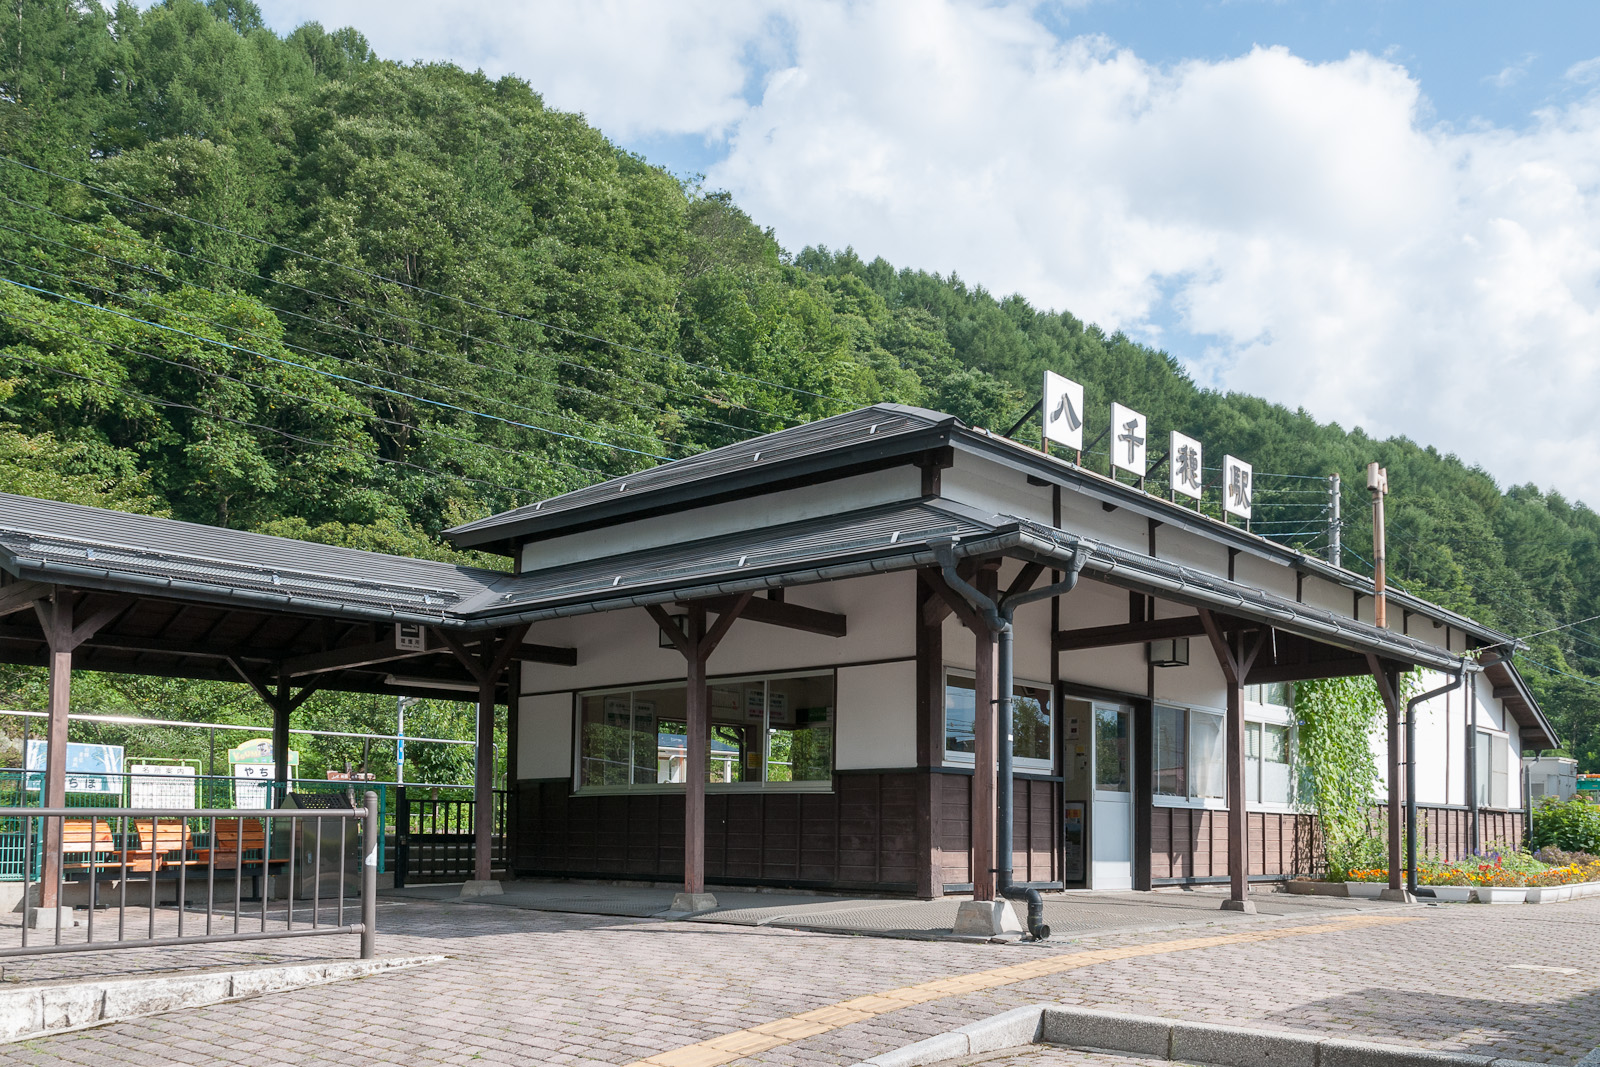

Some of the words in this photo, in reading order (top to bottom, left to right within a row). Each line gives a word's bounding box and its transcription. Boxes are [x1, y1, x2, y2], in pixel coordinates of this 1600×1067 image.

[1050, 392, 1251, 510] 八千穂駅
[142, 766, 185, 774] 名所案内
[244, 766, 269, 777] やち
[68, 777, 96, 789] ちほ
